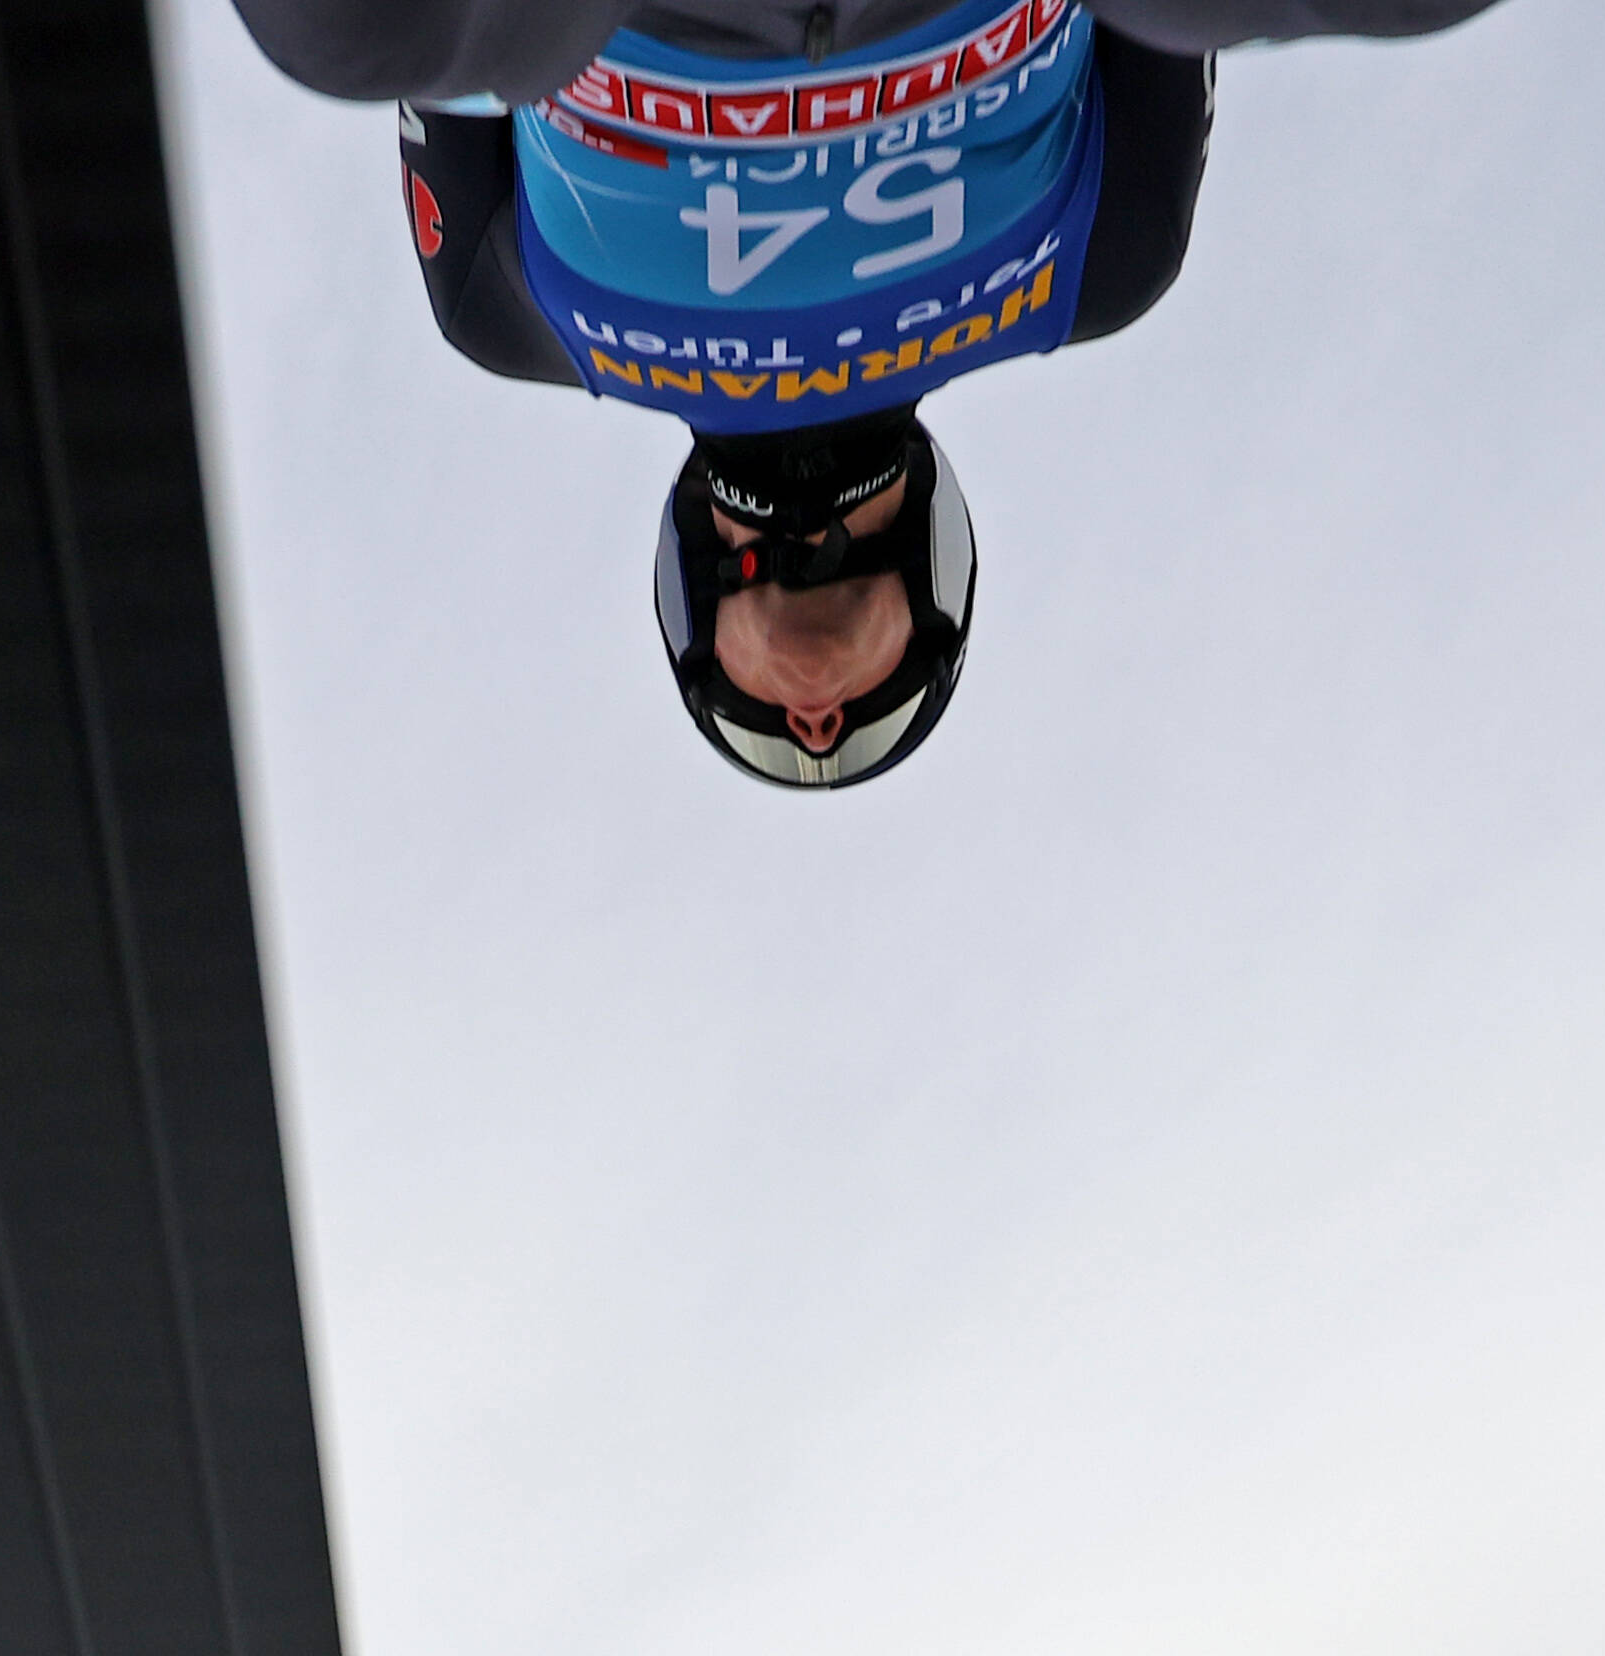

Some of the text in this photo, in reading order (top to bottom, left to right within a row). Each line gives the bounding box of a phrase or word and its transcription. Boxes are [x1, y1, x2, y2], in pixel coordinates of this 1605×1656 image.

[679, 148, 964, 296] 54
[573, 231, 1062, 370] Tore Türen
[592, 261, 1055, 403] HÖRMANN
